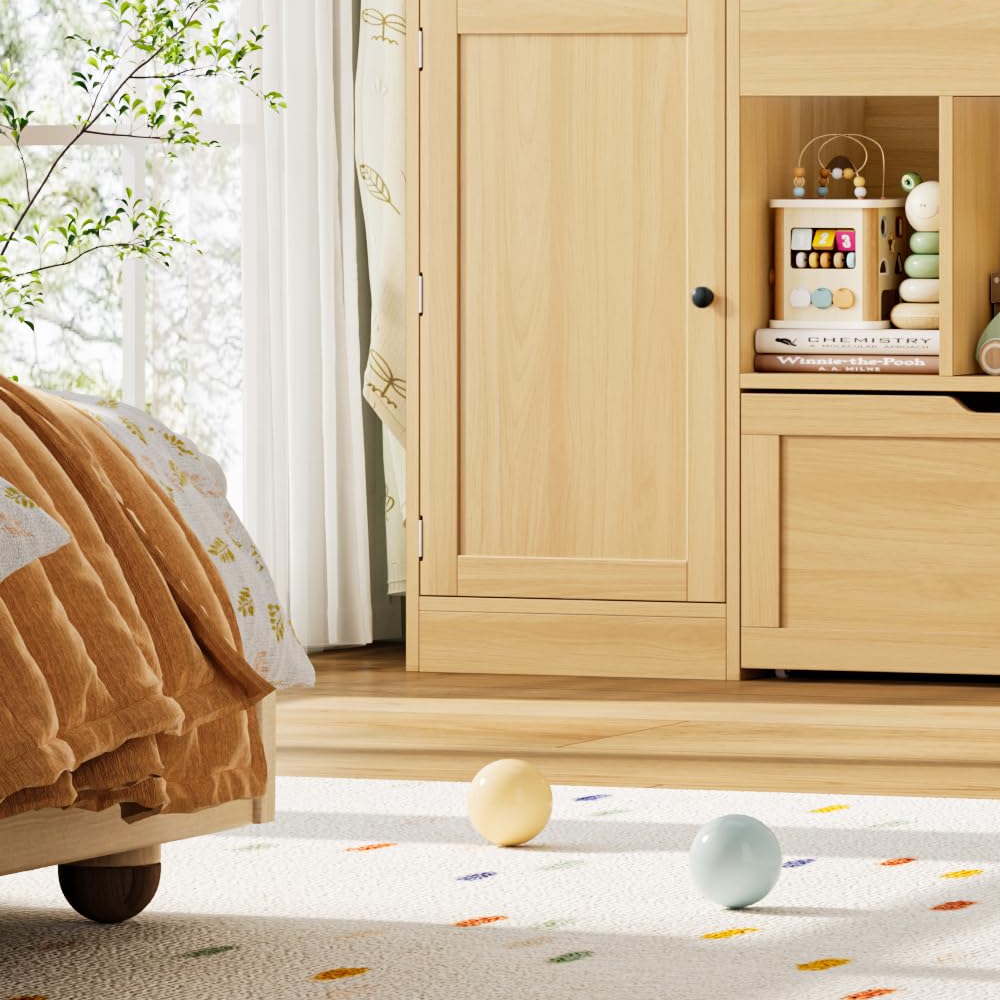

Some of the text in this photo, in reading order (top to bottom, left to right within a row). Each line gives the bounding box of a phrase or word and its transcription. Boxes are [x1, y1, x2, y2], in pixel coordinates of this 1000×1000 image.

[817, 231, 853, 250] 2 3
[808, 336, 932, 344] CHEMISTRY
[776, 355, 927, 367] Winnie-the-Pooh
